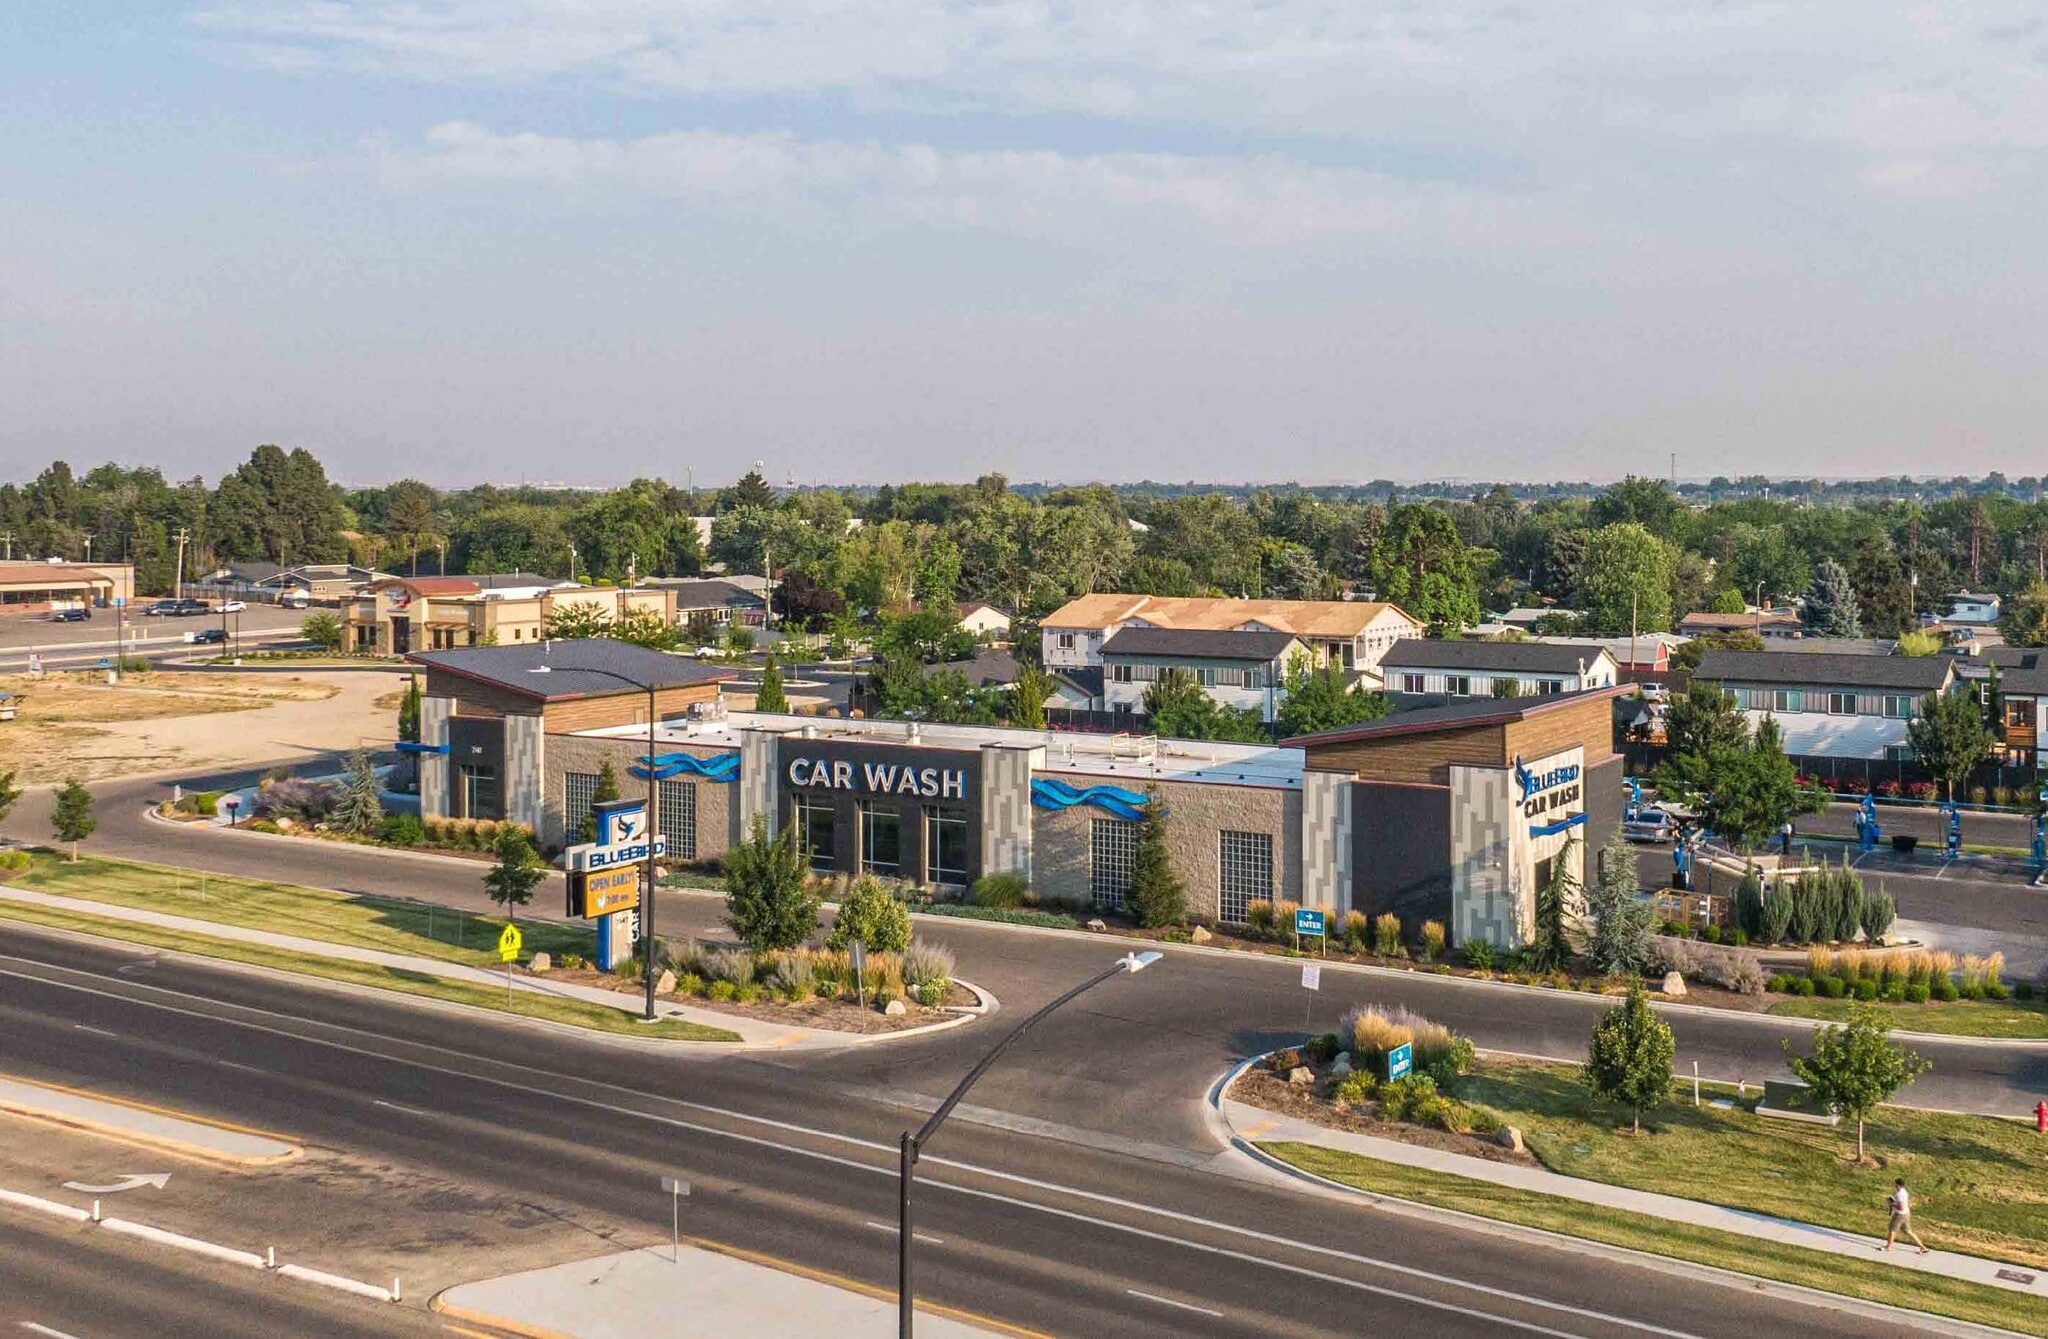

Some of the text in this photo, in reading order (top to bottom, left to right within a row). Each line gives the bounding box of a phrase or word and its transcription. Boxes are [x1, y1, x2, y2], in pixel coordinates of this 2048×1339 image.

[790, 757, 966, 799] CAR WASH
[1524, 784, 1579, 819] CAR WASH
[632, 912, 640, 942] CAR
[1299, 920, 1321, 930] ENTER
